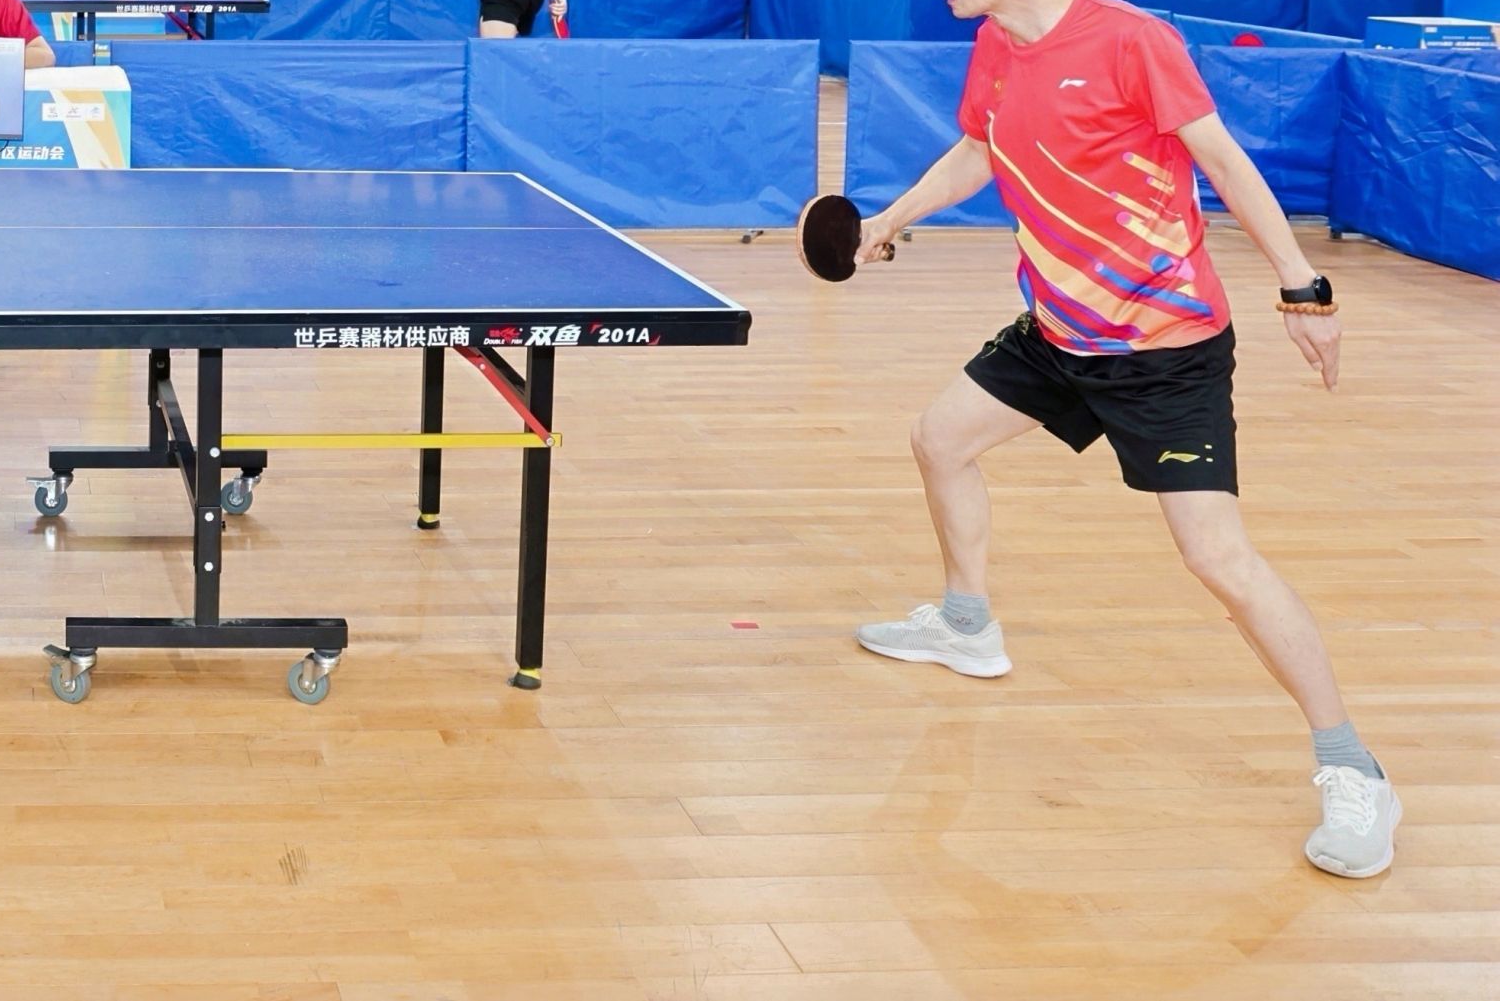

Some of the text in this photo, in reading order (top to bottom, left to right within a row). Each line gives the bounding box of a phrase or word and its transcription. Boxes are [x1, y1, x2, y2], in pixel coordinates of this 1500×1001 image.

[294, 326, 471, 348] 世乒赛器材供应商
[525, 325, 650, 346] 双鱼 201A
